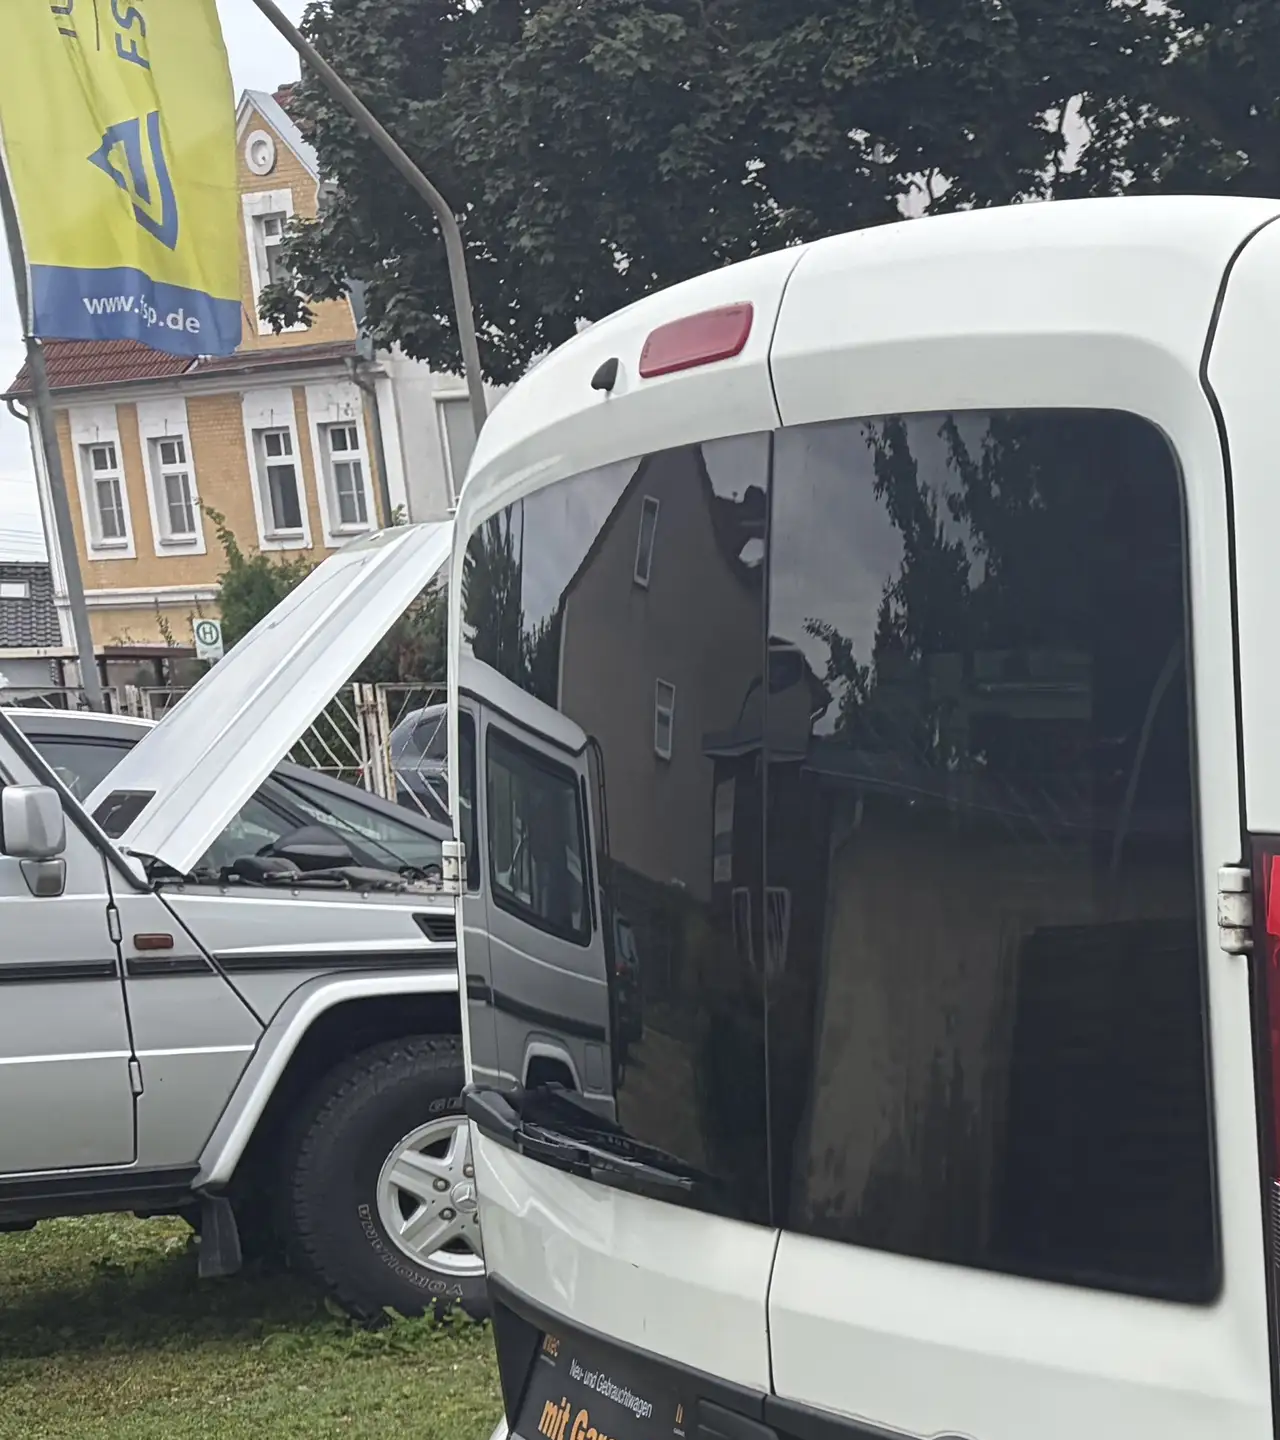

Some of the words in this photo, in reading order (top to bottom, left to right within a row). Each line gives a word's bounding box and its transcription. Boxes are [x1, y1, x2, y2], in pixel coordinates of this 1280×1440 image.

[202, 626, 214, 641] H
[584, 1368, 598, 1389] und
[597, 1371, 653, 1419] Gebrauchtwagen
